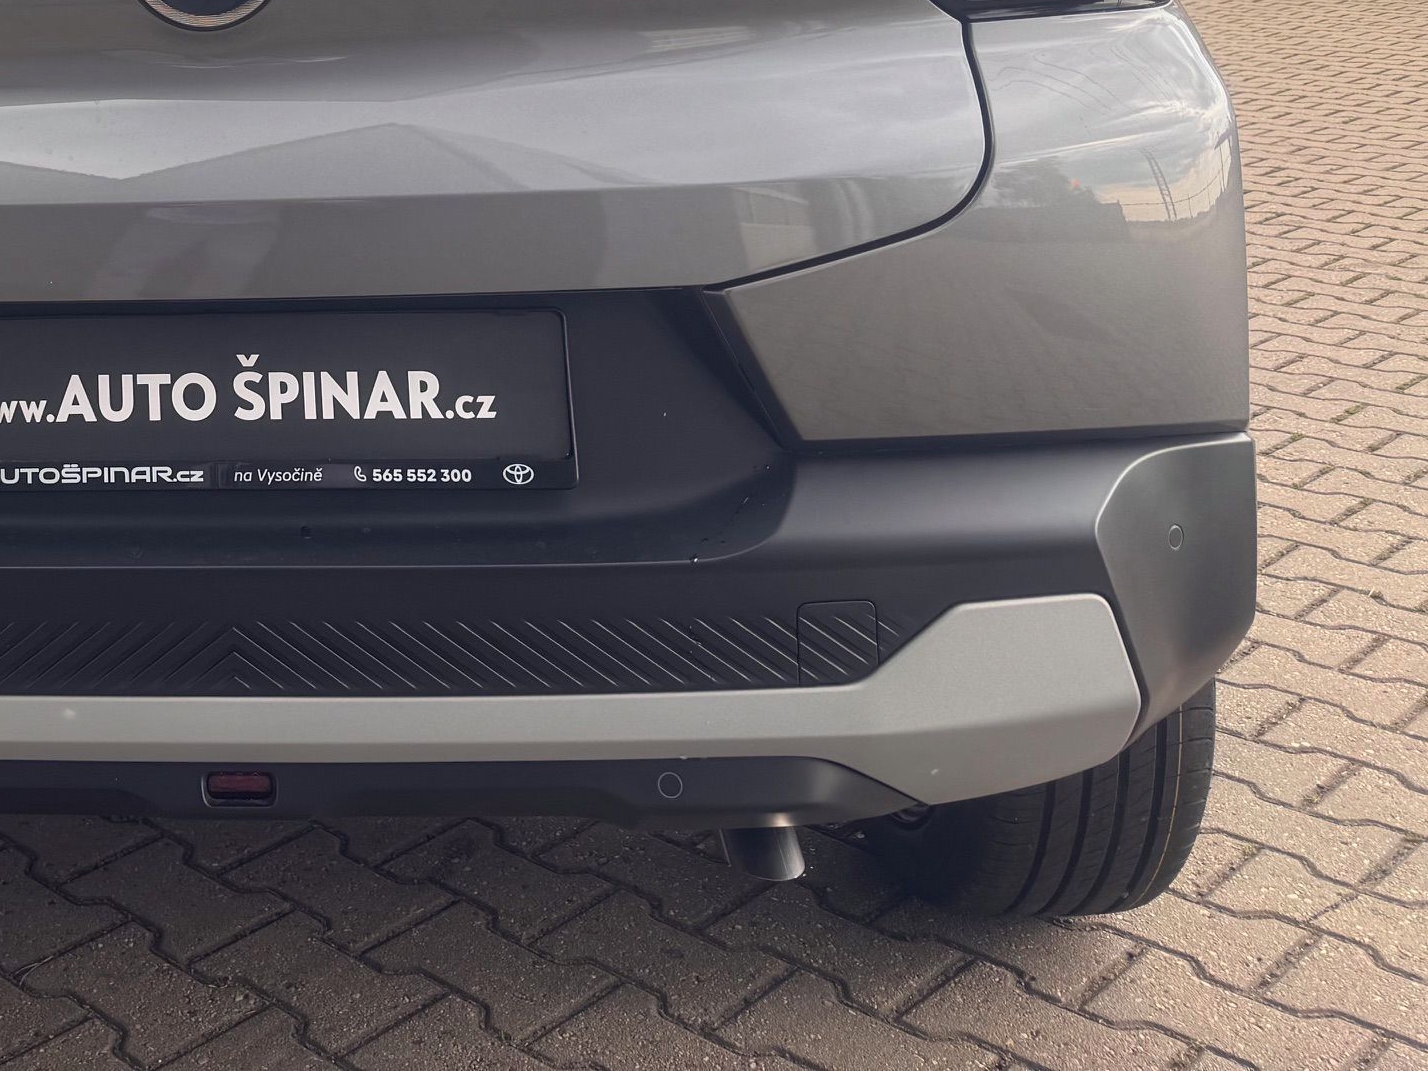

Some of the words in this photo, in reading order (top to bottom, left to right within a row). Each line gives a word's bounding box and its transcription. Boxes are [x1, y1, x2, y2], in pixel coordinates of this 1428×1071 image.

[233, 354, 497, 421] ŠPINAR.cz
[234, 470, 252, 482] na
[257, 467, 323, 486] Vysočině
[372, 469, 403, 483] 565
[406, 469, 437, 483] 552
[440, 469, 472, 483] 300
